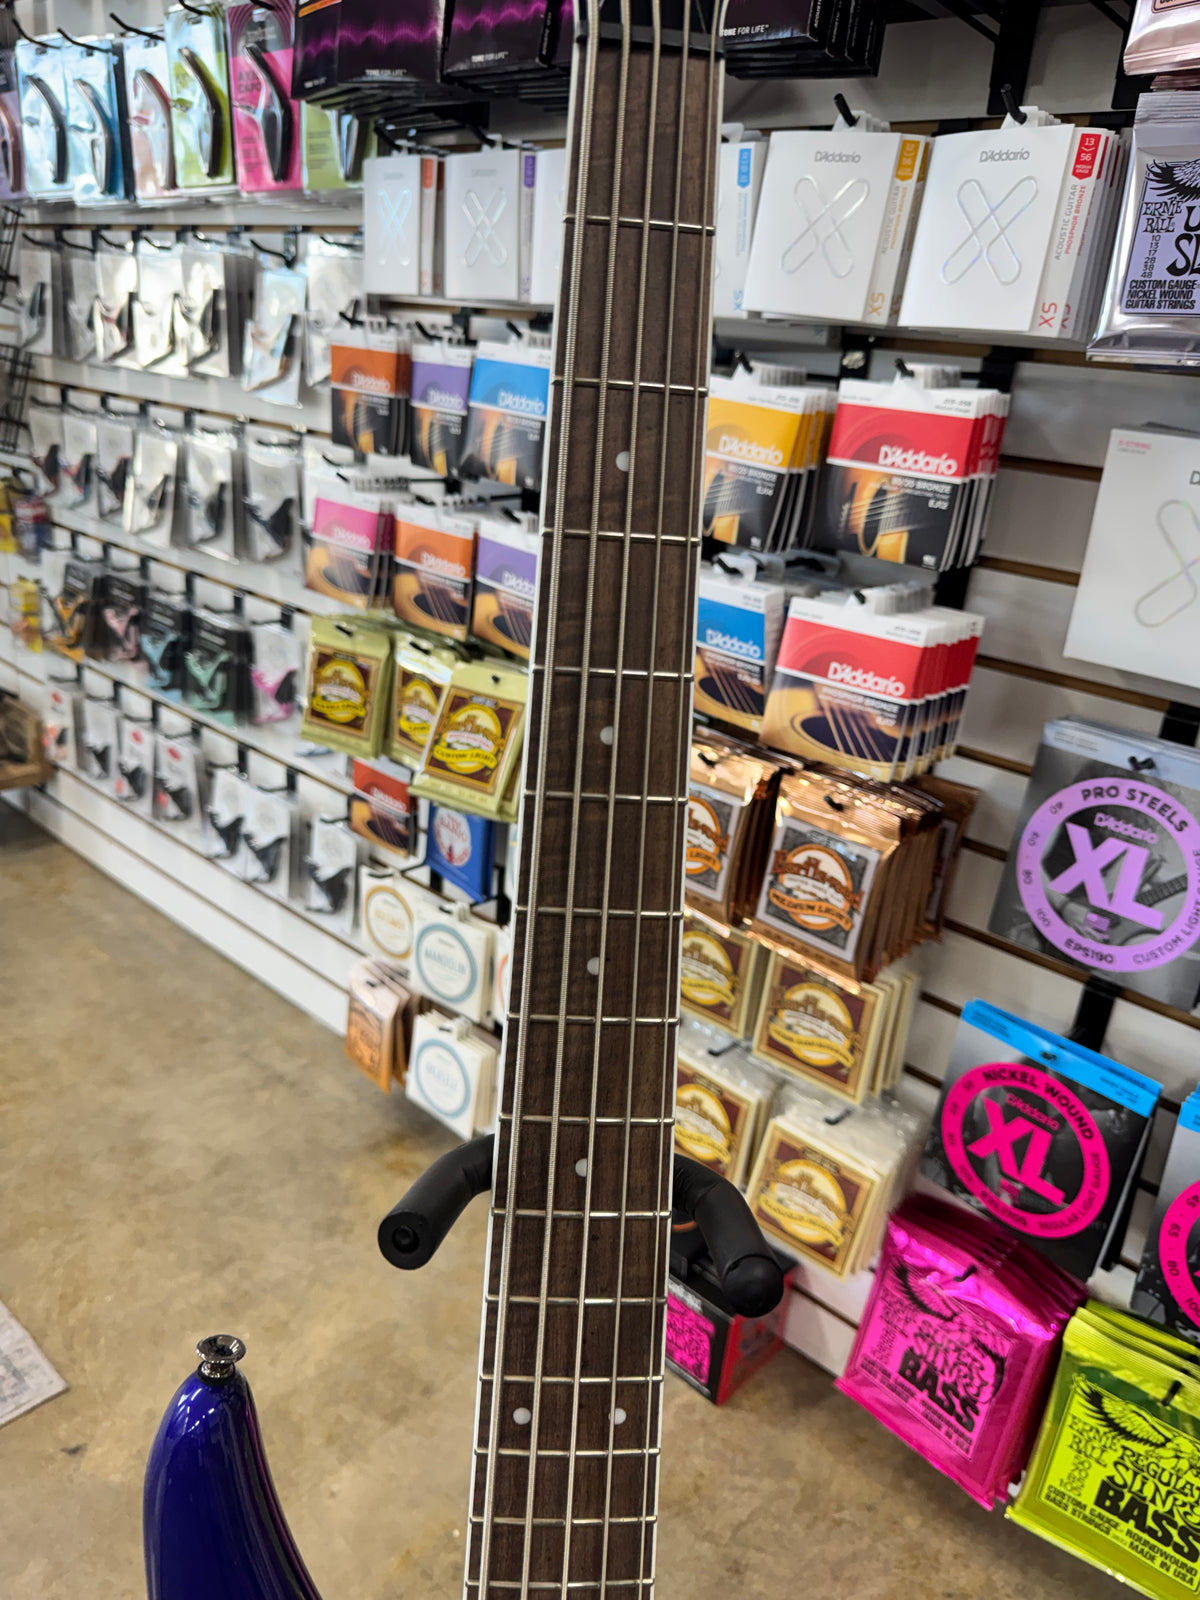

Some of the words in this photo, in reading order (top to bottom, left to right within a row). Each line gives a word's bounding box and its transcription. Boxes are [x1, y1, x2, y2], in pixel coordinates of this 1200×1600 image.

[722, 28, 737, 37] ONE
[737, 26, 750, 35] FOR
[979, 148, 1030, 163] D'Addario
[1085, 137, 1095, 146] 13
[1079, 153, 1091, 162] 56
[1075, 185, 1087, 214] BRONZE
[1142, 199, 1183, 216] ERNIE
[1055, 217, 1071, 260] ACOUSTIC
[1065, 184, 1078, 216] GUITAR
[1143, 217, 1175, 233] BALL
[1127, 290, 1157, 299] NICKEL
[1159, 290, 1193, 299] WOUND
[1129, 280, 1166, 289] CUSTOM
[1167, 280, 1197, 289] GAUGE
[868, 292, 885, 317] XS
[1038, 302, 1058, 328] XS
[1125, 300, 1155, 309] GUITAR
[1156, 300, 1196, 310] STRINGS
[718, 433, 783, 466] D'Addario
[878, 444, 957, 475] D'Addario
[706, 628, 761, 658] D'Addario
[827, 661, 905, 697] D'Addario
[1081, 786, 1120, 801] PRO
[1126, 789, 1189, 833] STEELS
[1094, 812, 1160, 845] D'Addario
[1049, 822, 1165, 930] XL
[1132, 935, 1183, 965] CUSTOM
[983, 1069, 1039, 1089] NICKEL
[1044, 1082, 1094, 1141] WOUND
[966, 1095, 1066, 1206] XL
[897, 1346, 980, 1433] BASS
[1048, 1484, 1088, 1511] CUSTOM
[1125, 1528, 1198, 1577] ROUNDWOUND
[1094, 1479, 1200, 1563] BASS
[1128, 1541, 1157, 1565] MADE
[1159, 1560, 1171, 1573] IN
[1173, 1566, 1195, 1586] USA
